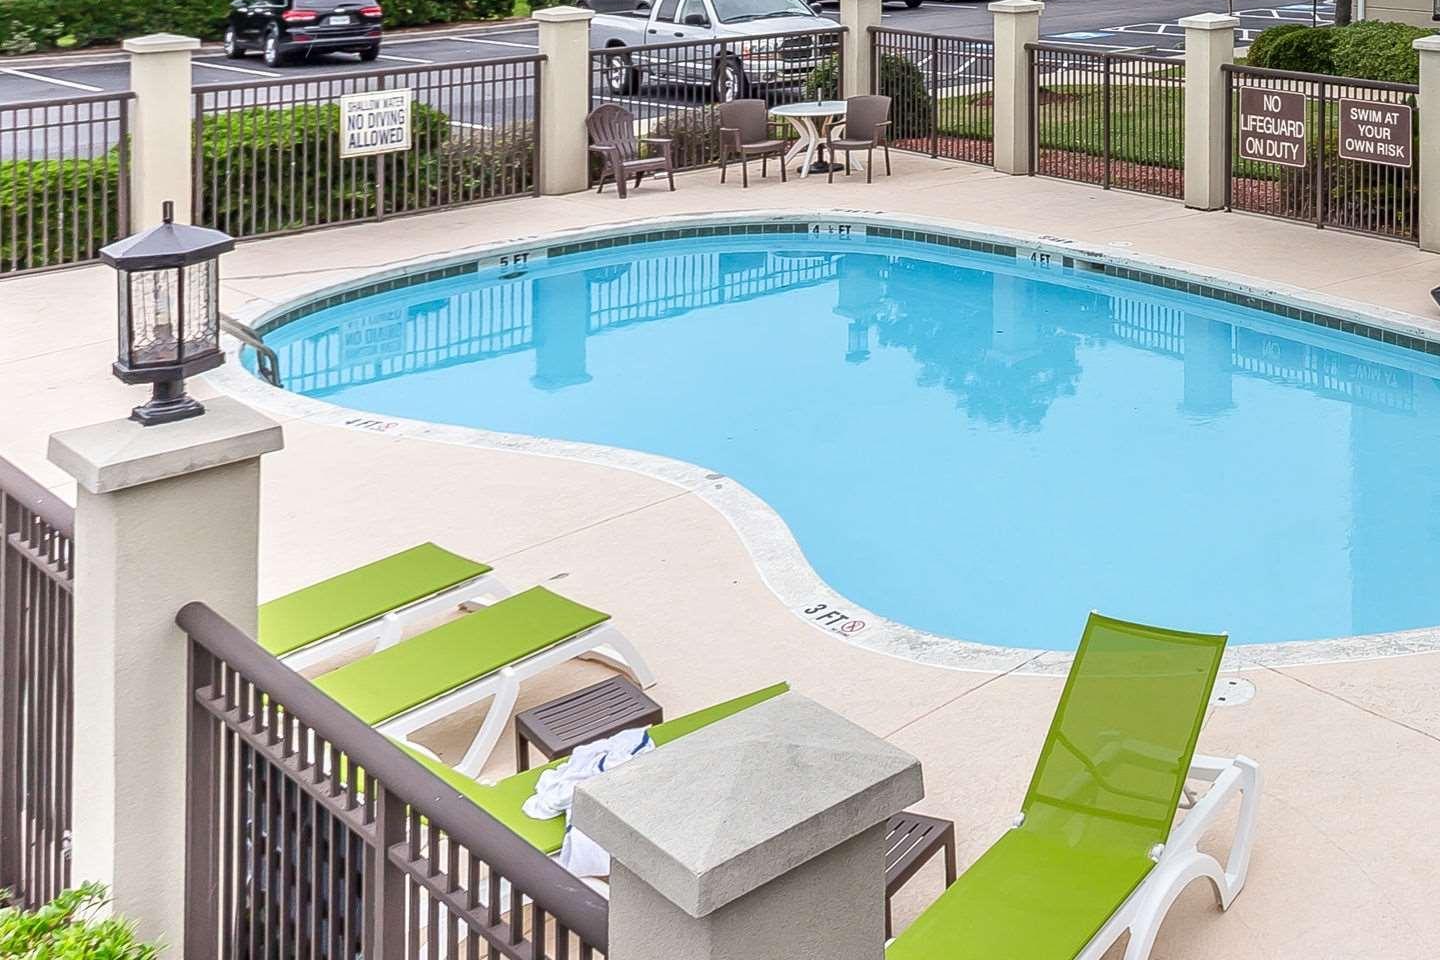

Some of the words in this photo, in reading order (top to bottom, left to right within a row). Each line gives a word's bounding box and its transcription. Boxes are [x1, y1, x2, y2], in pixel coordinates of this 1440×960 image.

[1263, 94, 1281, 113] NO
[347, 113, 364, 131] NO
[367, 108, 405, 129] DIVING
[1350, 107, 1382, 123] SWIM
[1384, 112, 1400, 125] AT
[1240, 113, 1305, 138] LIFEGUARD
[1358, 124, 1391, 140] YOUR
[348, 127, 404, 149] ALLOWED
[1245, 136, 1264, 155] ON
[1266, 139, 1299, 161] DUTY
[1345, 138, 1375, 154] OWN
[1377, 144, 1405, 159] RISK
[812, 224, 820, 233] 4
[838, 224, 852, 235] FT
[499, 255, 509, 267] 5
[513, 252, 530, 265] FT
[1030, 251, 1037, 261] 4
[1039, 253, 1051, 264] FT
[804, 603, 827, 615] 3
[815, 610, 850, 626] FT
